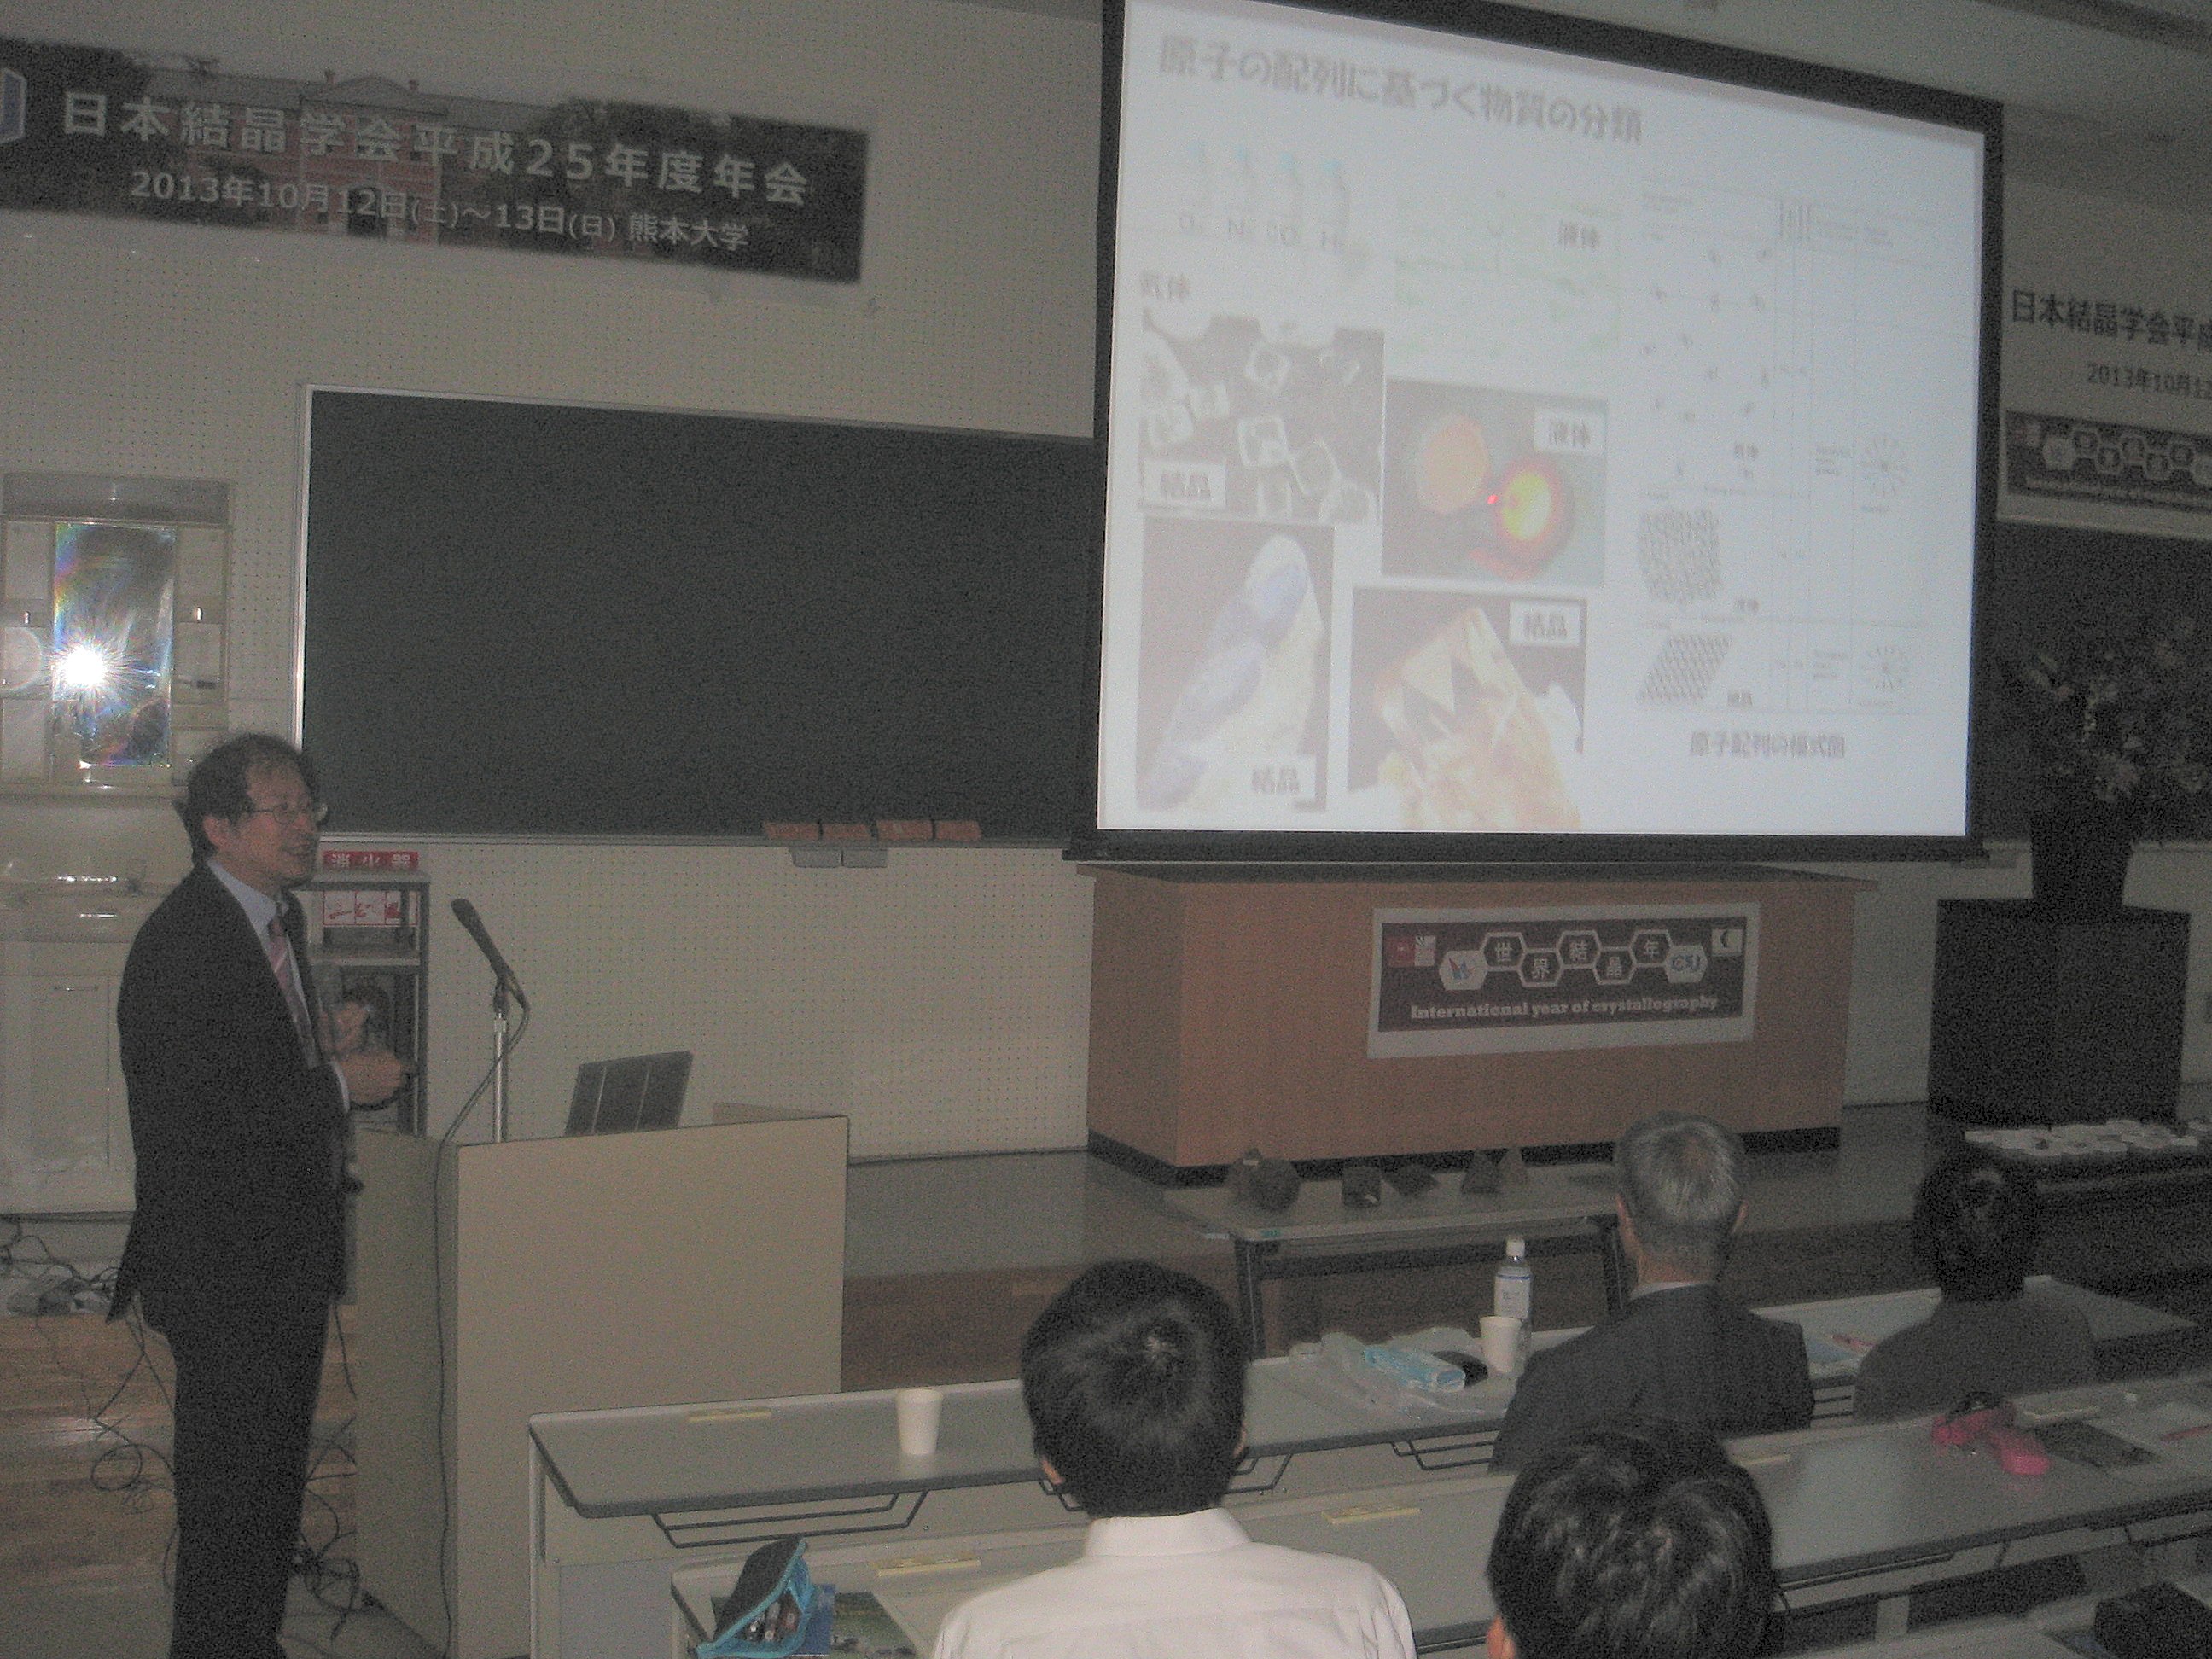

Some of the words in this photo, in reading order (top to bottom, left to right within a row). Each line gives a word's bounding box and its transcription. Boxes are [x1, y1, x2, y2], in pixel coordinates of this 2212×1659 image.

[1159, 35, 1644, 145] 原子の配列に基づく物質の分類
[62, 90, 808, 208] 日本結晶学会平成25年度年会
[628, 210, 750, 252] 熊本大学
[1410, 1001, 1529, 1020] International
[1532, 999, 1569, 1018] year
[1572, 999, 1592, 1013] of
[1593, 994, 1719, 1015] crystallography
